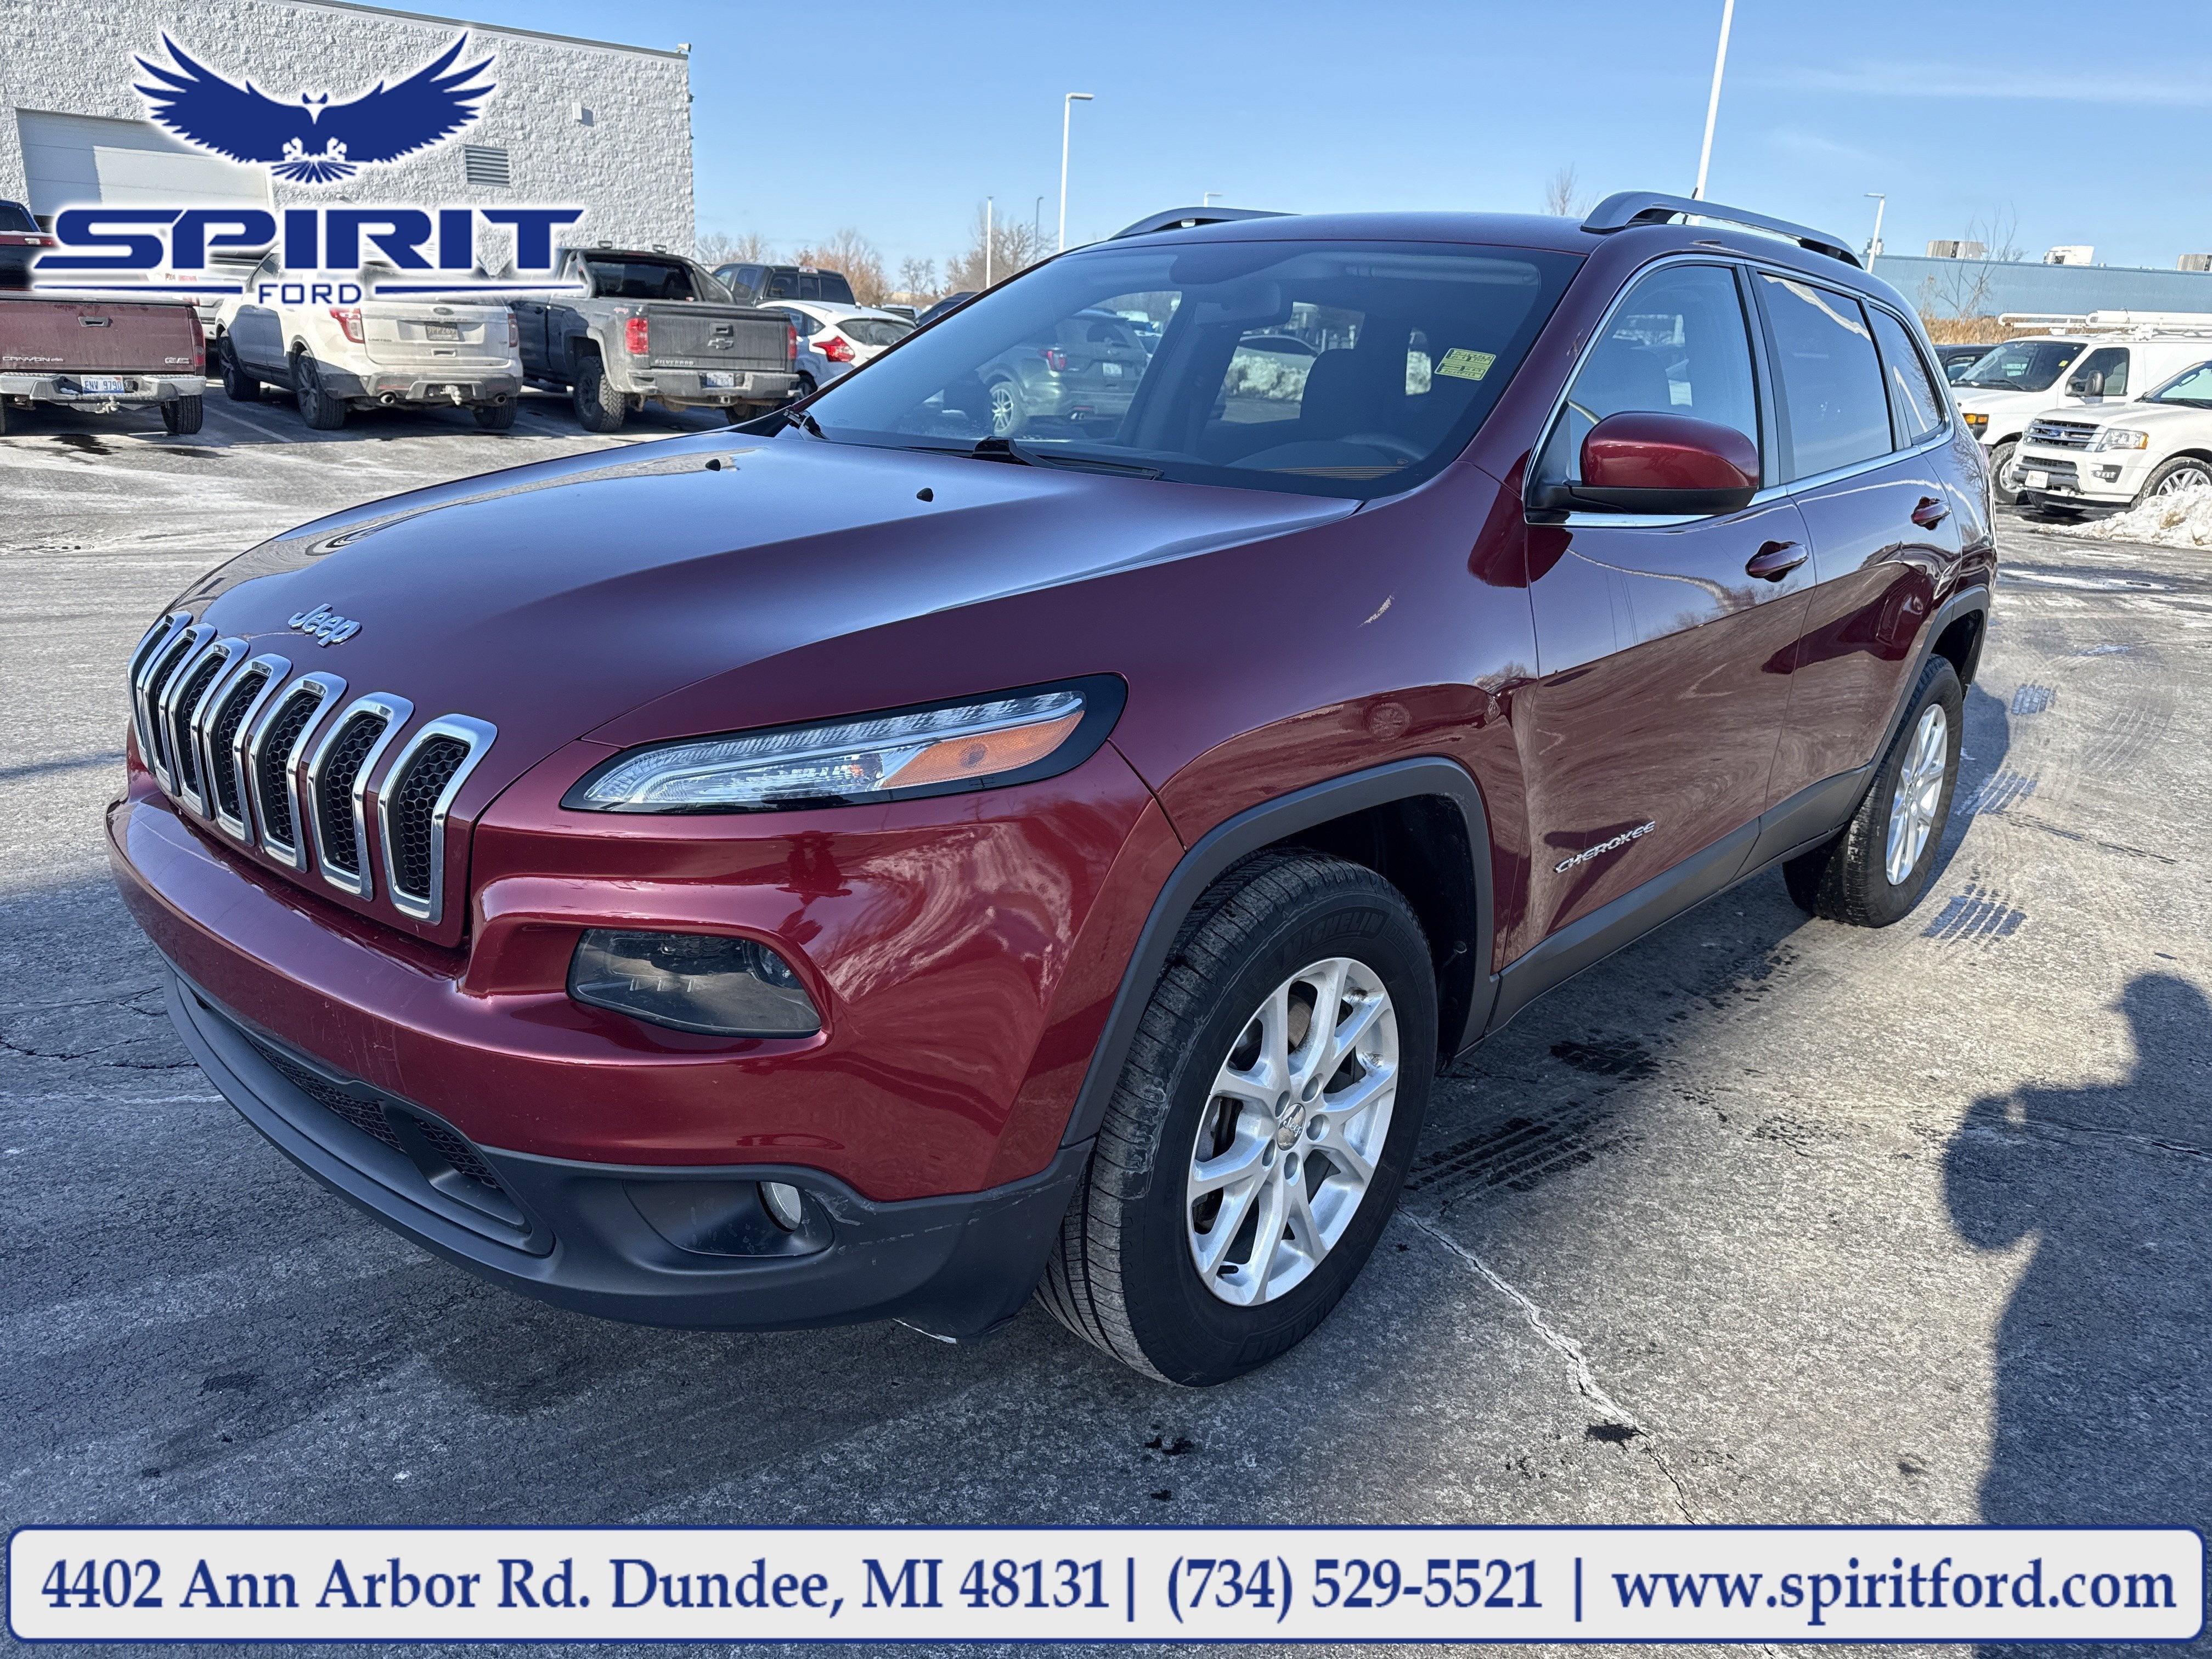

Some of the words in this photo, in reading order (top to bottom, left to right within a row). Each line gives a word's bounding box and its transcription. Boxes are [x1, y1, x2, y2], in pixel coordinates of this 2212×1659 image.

[84, 380, 99, 390] ENV
[103, 381, 122, 390] 9790
[287, 603, 363, 648] Jeep
[1554, 820, 1656, 873] CHEROKEE
[1283, 1117, 1302, 1137] Jeep
